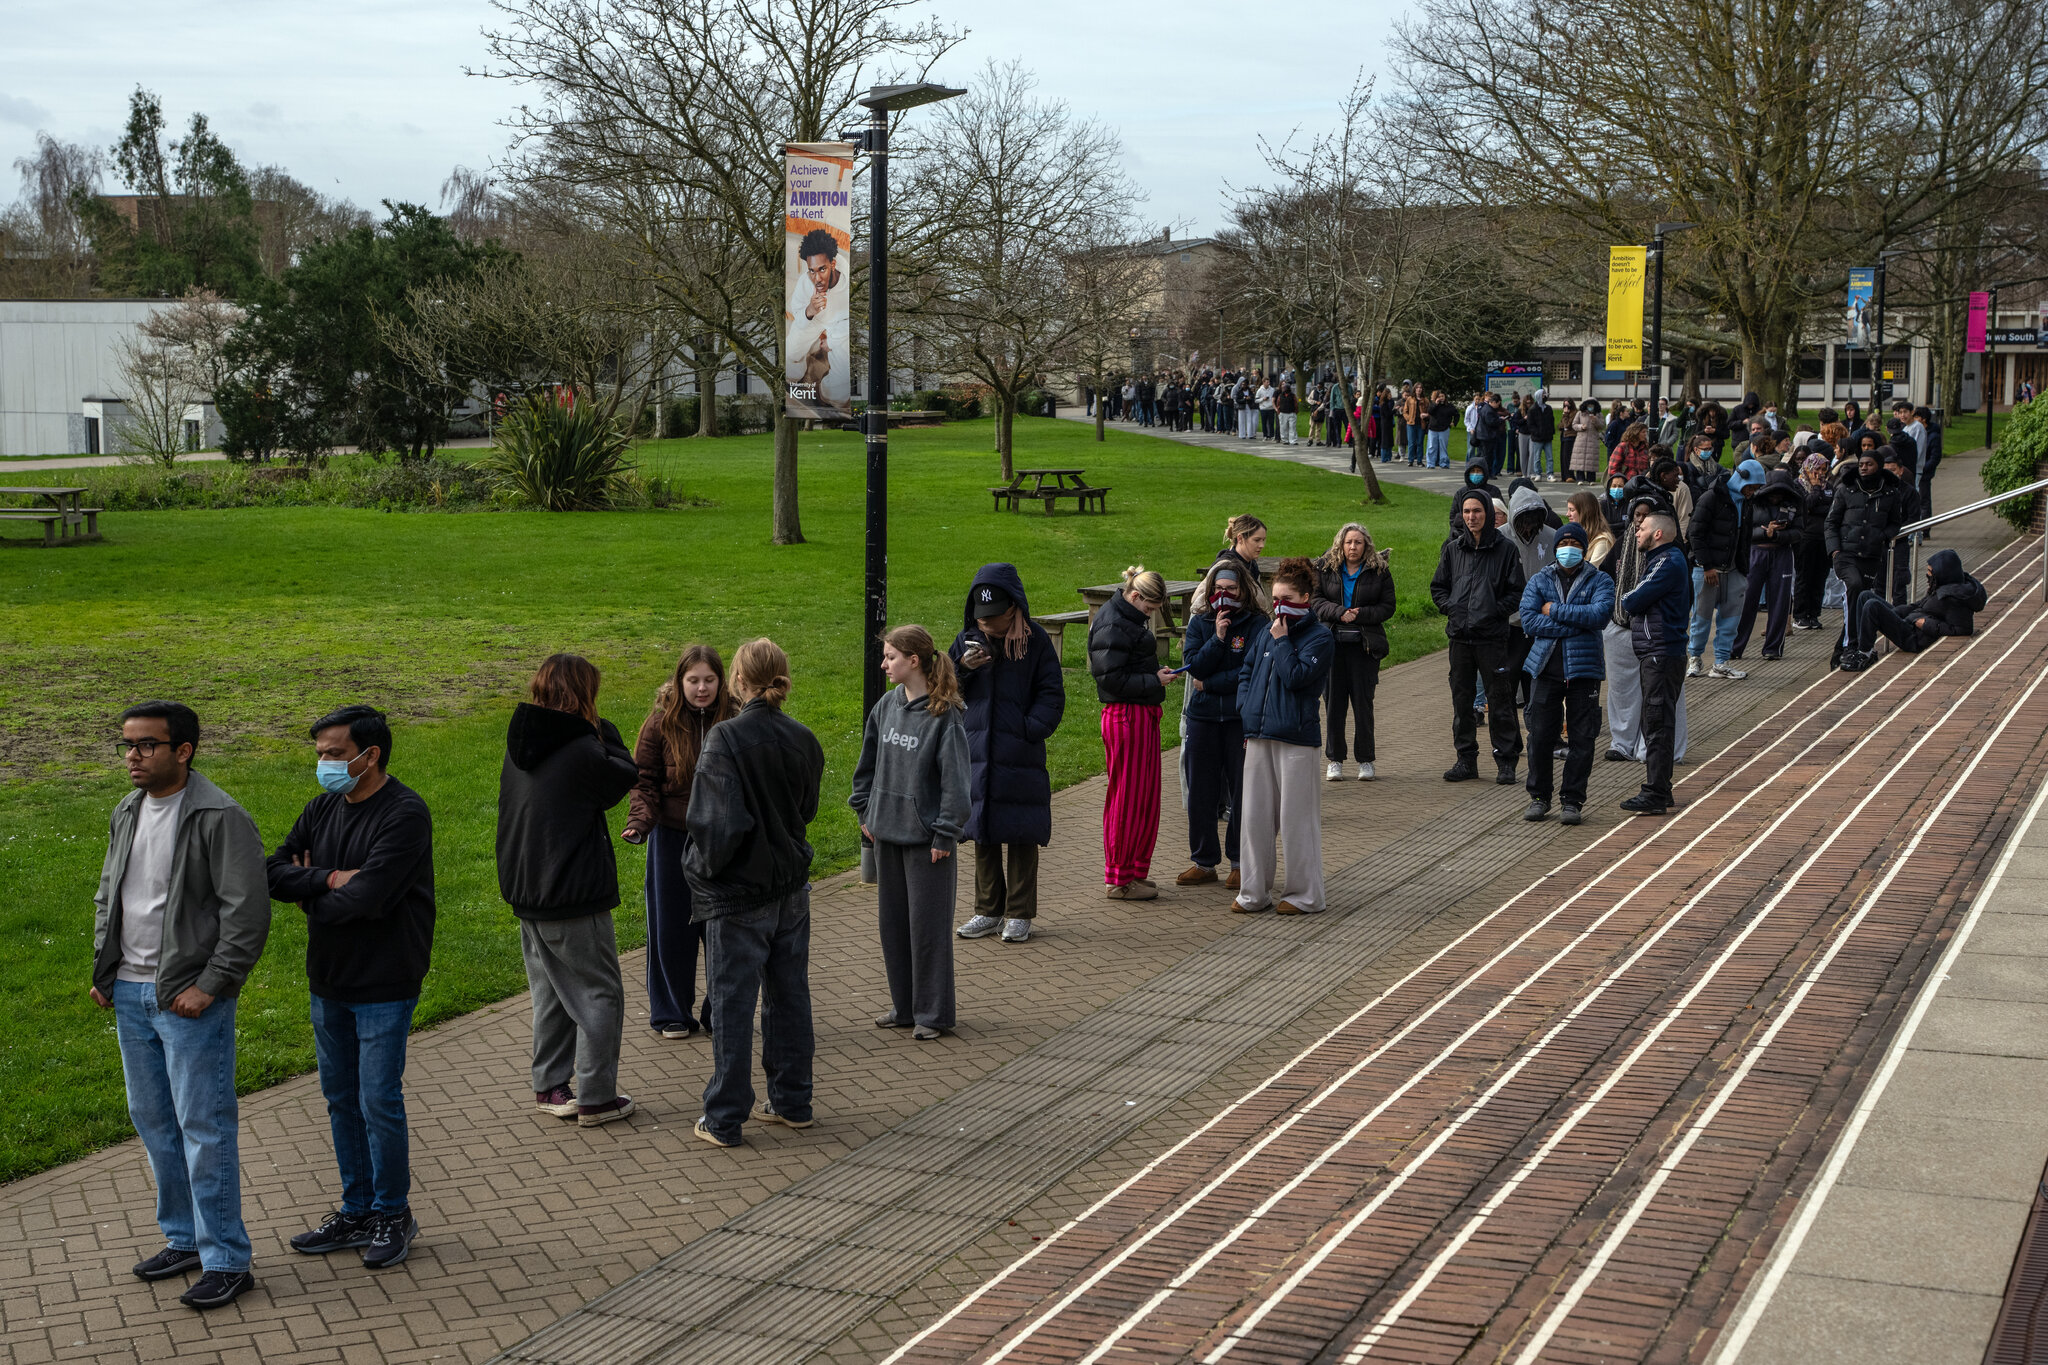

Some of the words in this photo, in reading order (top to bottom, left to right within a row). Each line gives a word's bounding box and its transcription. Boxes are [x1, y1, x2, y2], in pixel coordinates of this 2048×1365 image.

[790, 164, 829, 176] Achieve
[790, 179, 813, 190] your
[790, 191, 848, 206] AMBITION
[790, 208, 800, 219] at
[801, 208, 824, 219] Kent
[2008, 332, 2035, 342] South
[790, 386, 817, 400] Kent
[981, 588, 993, 602] NY
[882, 727, 919, 751] Jeep
